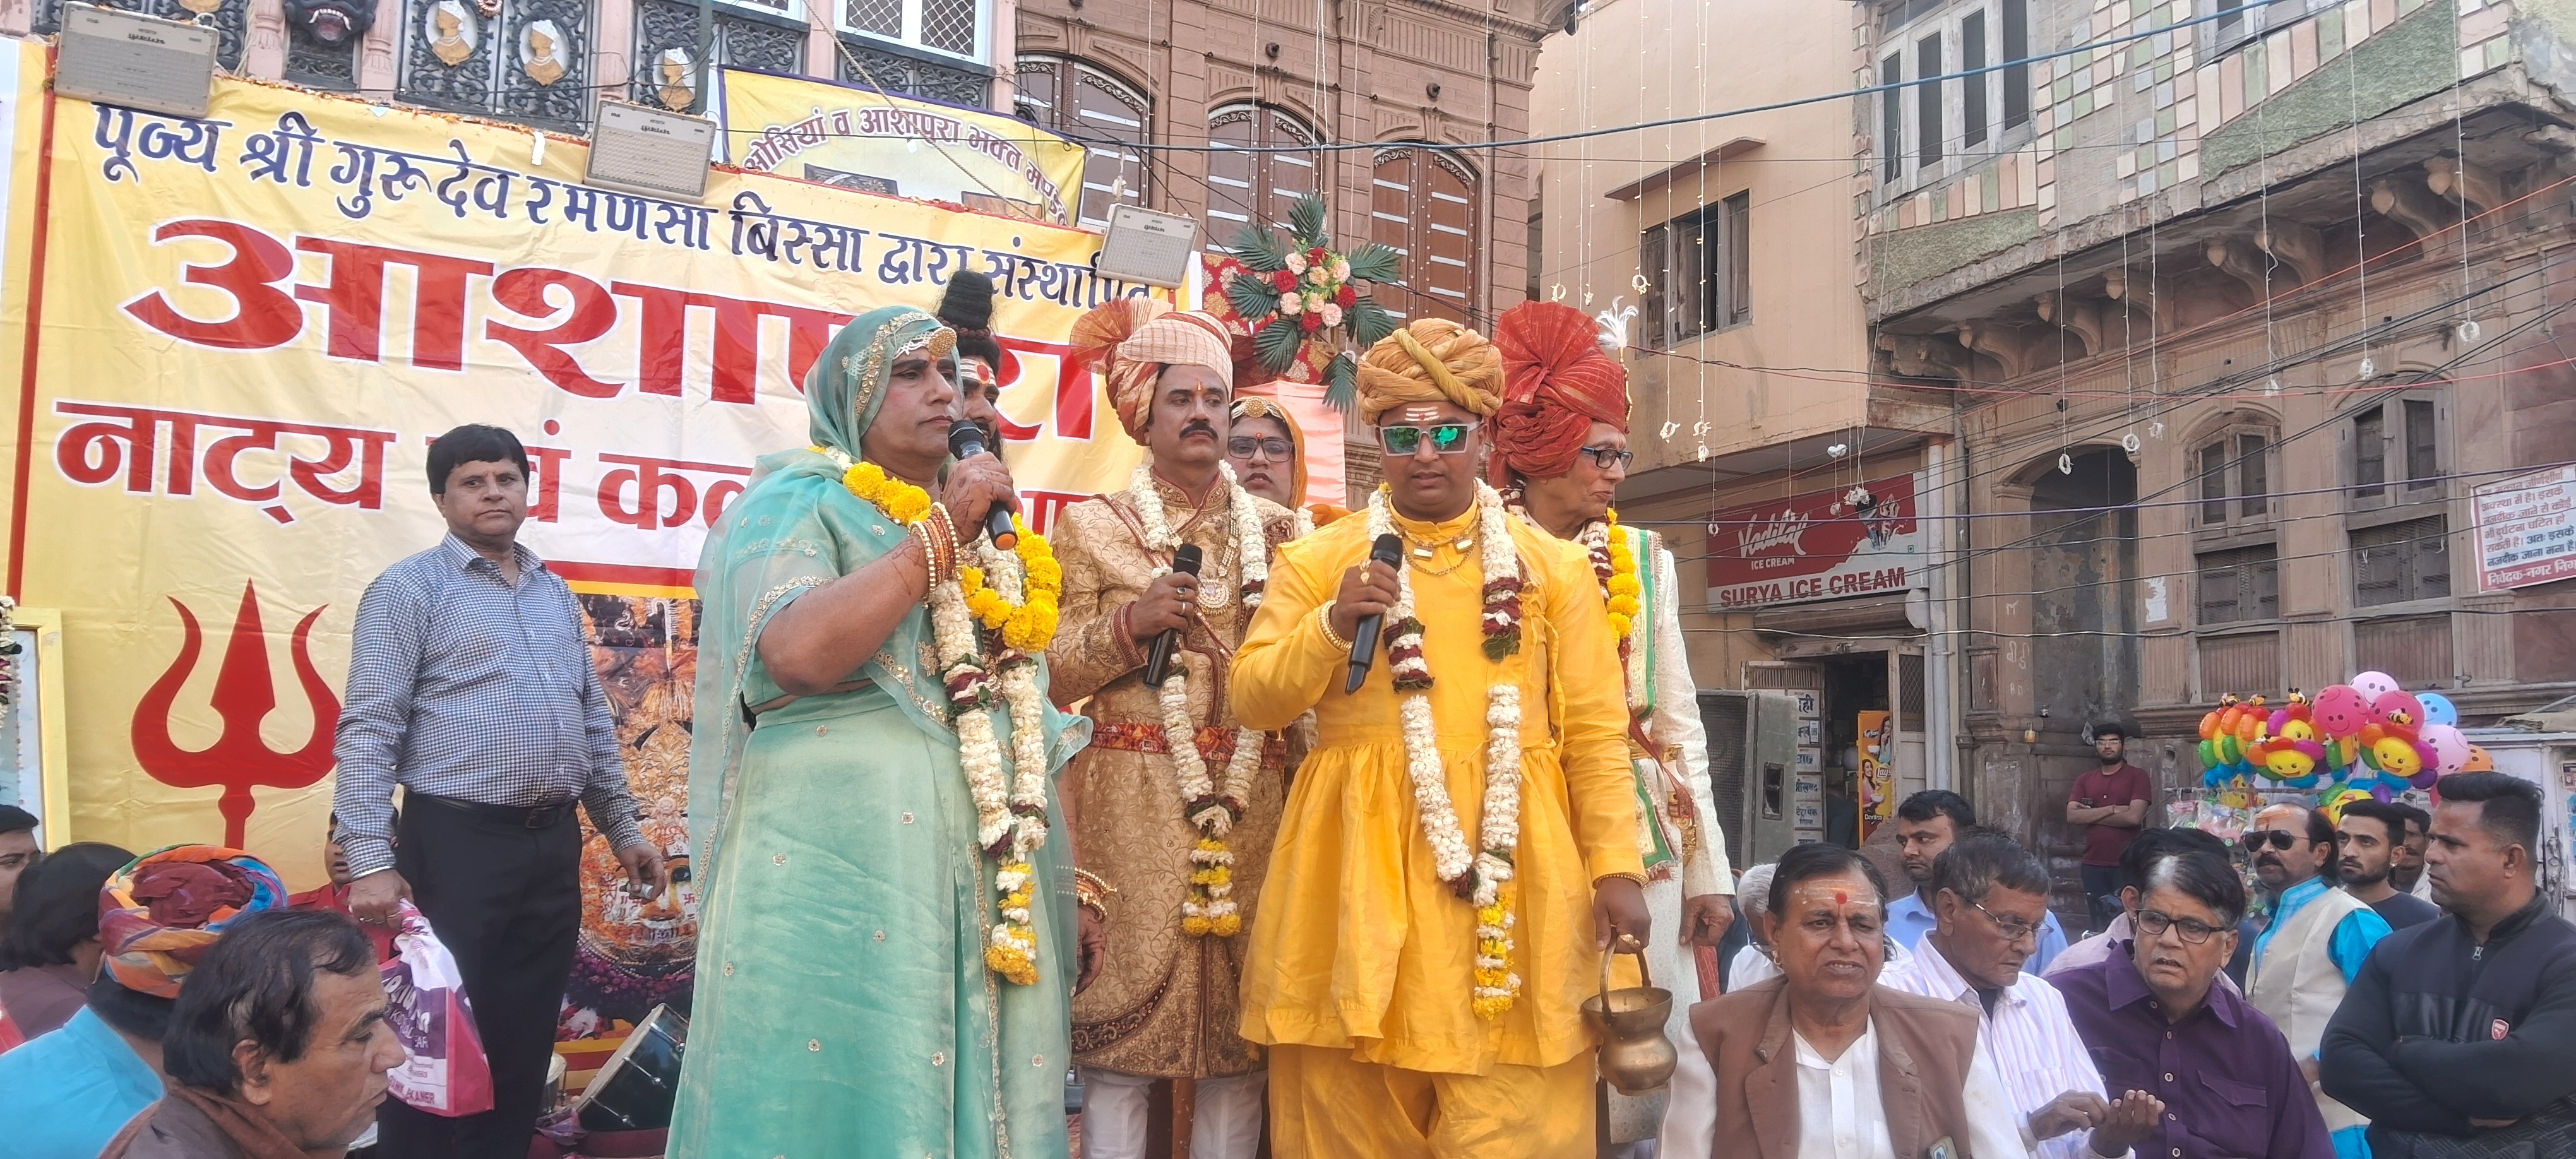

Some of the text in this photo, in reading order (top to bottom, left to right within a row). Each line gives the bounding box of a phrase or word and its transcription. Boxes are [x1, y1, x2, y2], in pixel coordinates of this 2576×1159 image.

[861, 109, 961, 145] आशापुरा
[967, 125, 1023, 171] भक्त
[240, 111, 325, 186] श्री
[730, 191, 870, 273] बिस्सा
[878, 232, 974, 286] द्वारा
[56, 401, 395, 524] नाट्य
[2481, 498, 2512, 511] अवस्था
[2514, 493, 2522, 504] में
[2538, 485, 2563, 499] इसके
[2483, 511, 2515, 525] नजदीक
[2519, 504, 2537, 517] जाने
[2541, 502, 2548, 513] से
[2485, 527, 2495, 538] भी
[2528, 517, 2553, 529] घटित
[1738, 511, 1808, 557] Vadilal
[2486, 538, 2511, 553] सकती
[2548, 525, 2575, 541] इसके
[1751, 556, 1794, 570] ICE CREAM
[2487, 552, 2519, 566] नजदीक
[2521, 548, 2543, 559] जाना
[2546, 544, 2565, 555] मना
[1720, 566, 1905, 607] SURYA ICE CREAM
